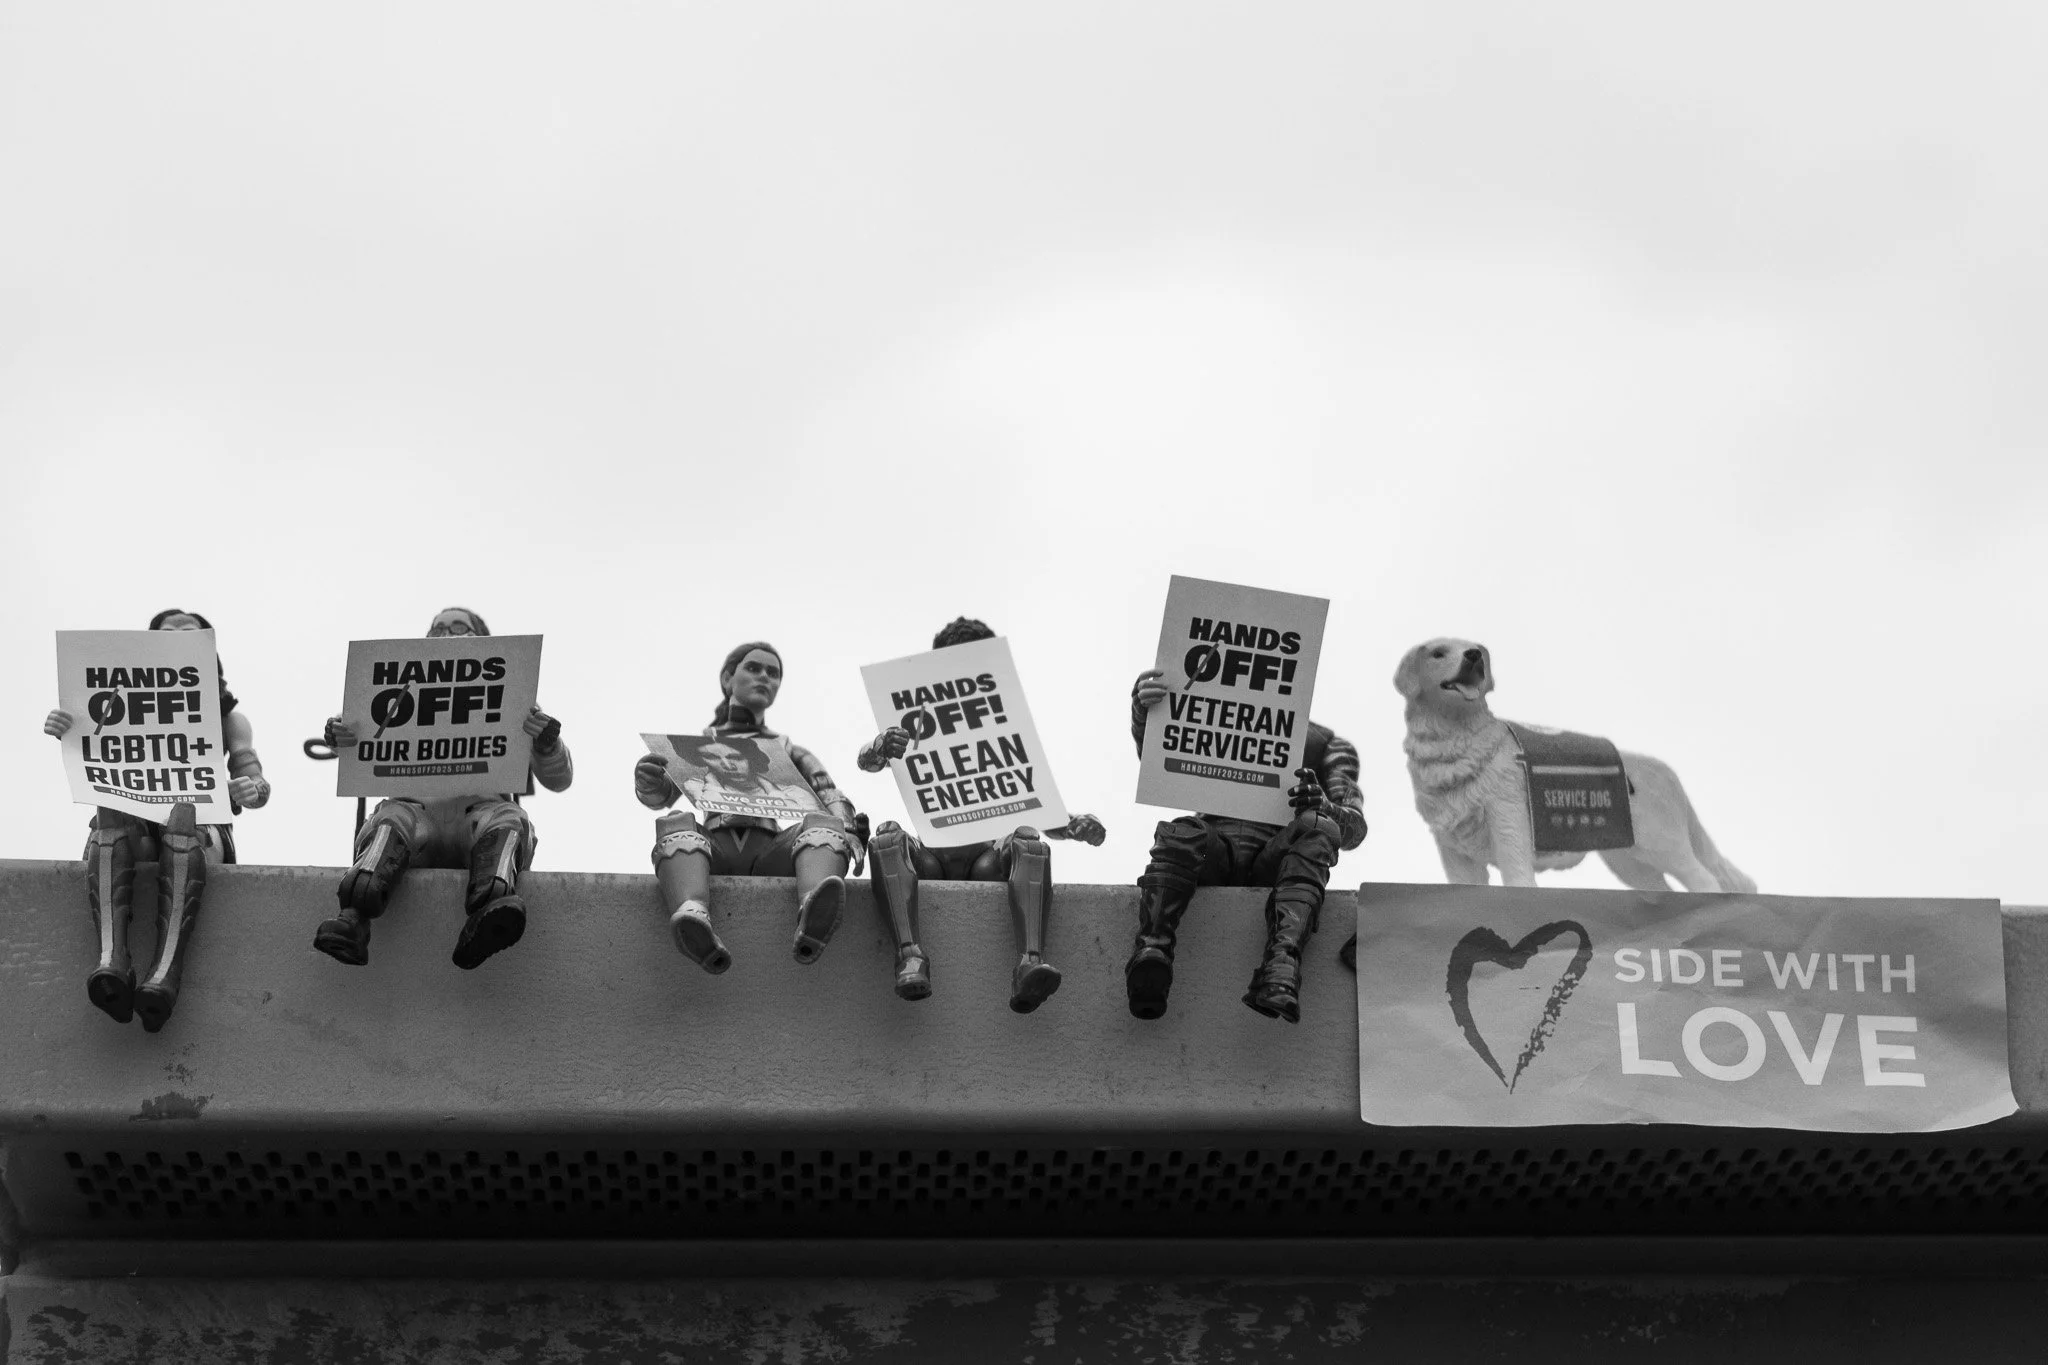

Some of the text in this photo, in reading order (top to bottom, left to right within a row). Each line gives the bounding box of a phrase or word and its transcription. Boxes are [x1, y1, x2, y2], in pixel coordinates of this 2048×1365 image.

[1189, 616, 1301, 655] HANDS
[86, 666, 200, 688] HANDS
[373, 657, 506, 685] HANDS
[891, 673, 997, 711] HANDS
[1169, 691, 1295, 739] VETERAN
[81, 733, 213, 764] LGBTQ+
[358, 735, 507, 762] OUR BODIES
[905, 733, 1029, 786] CLEAN
[1162, 724, 1291, 768] SERVICES
[85, 766, 216, 791] RIGHTS
[1180, 762, 1265, 783] HANDSOFF2025.COM
[723, 795, 784, 806] we are
[916, 766, 1035, 814] ENERGY
[1544, 790, 1612, 808] SERVICE DOG
[703, 801, 808, 817] the resistan
[1613, 948, 1916, 994] SIDE WITH
[1615, 1002, 1927, 1088] LOVE
